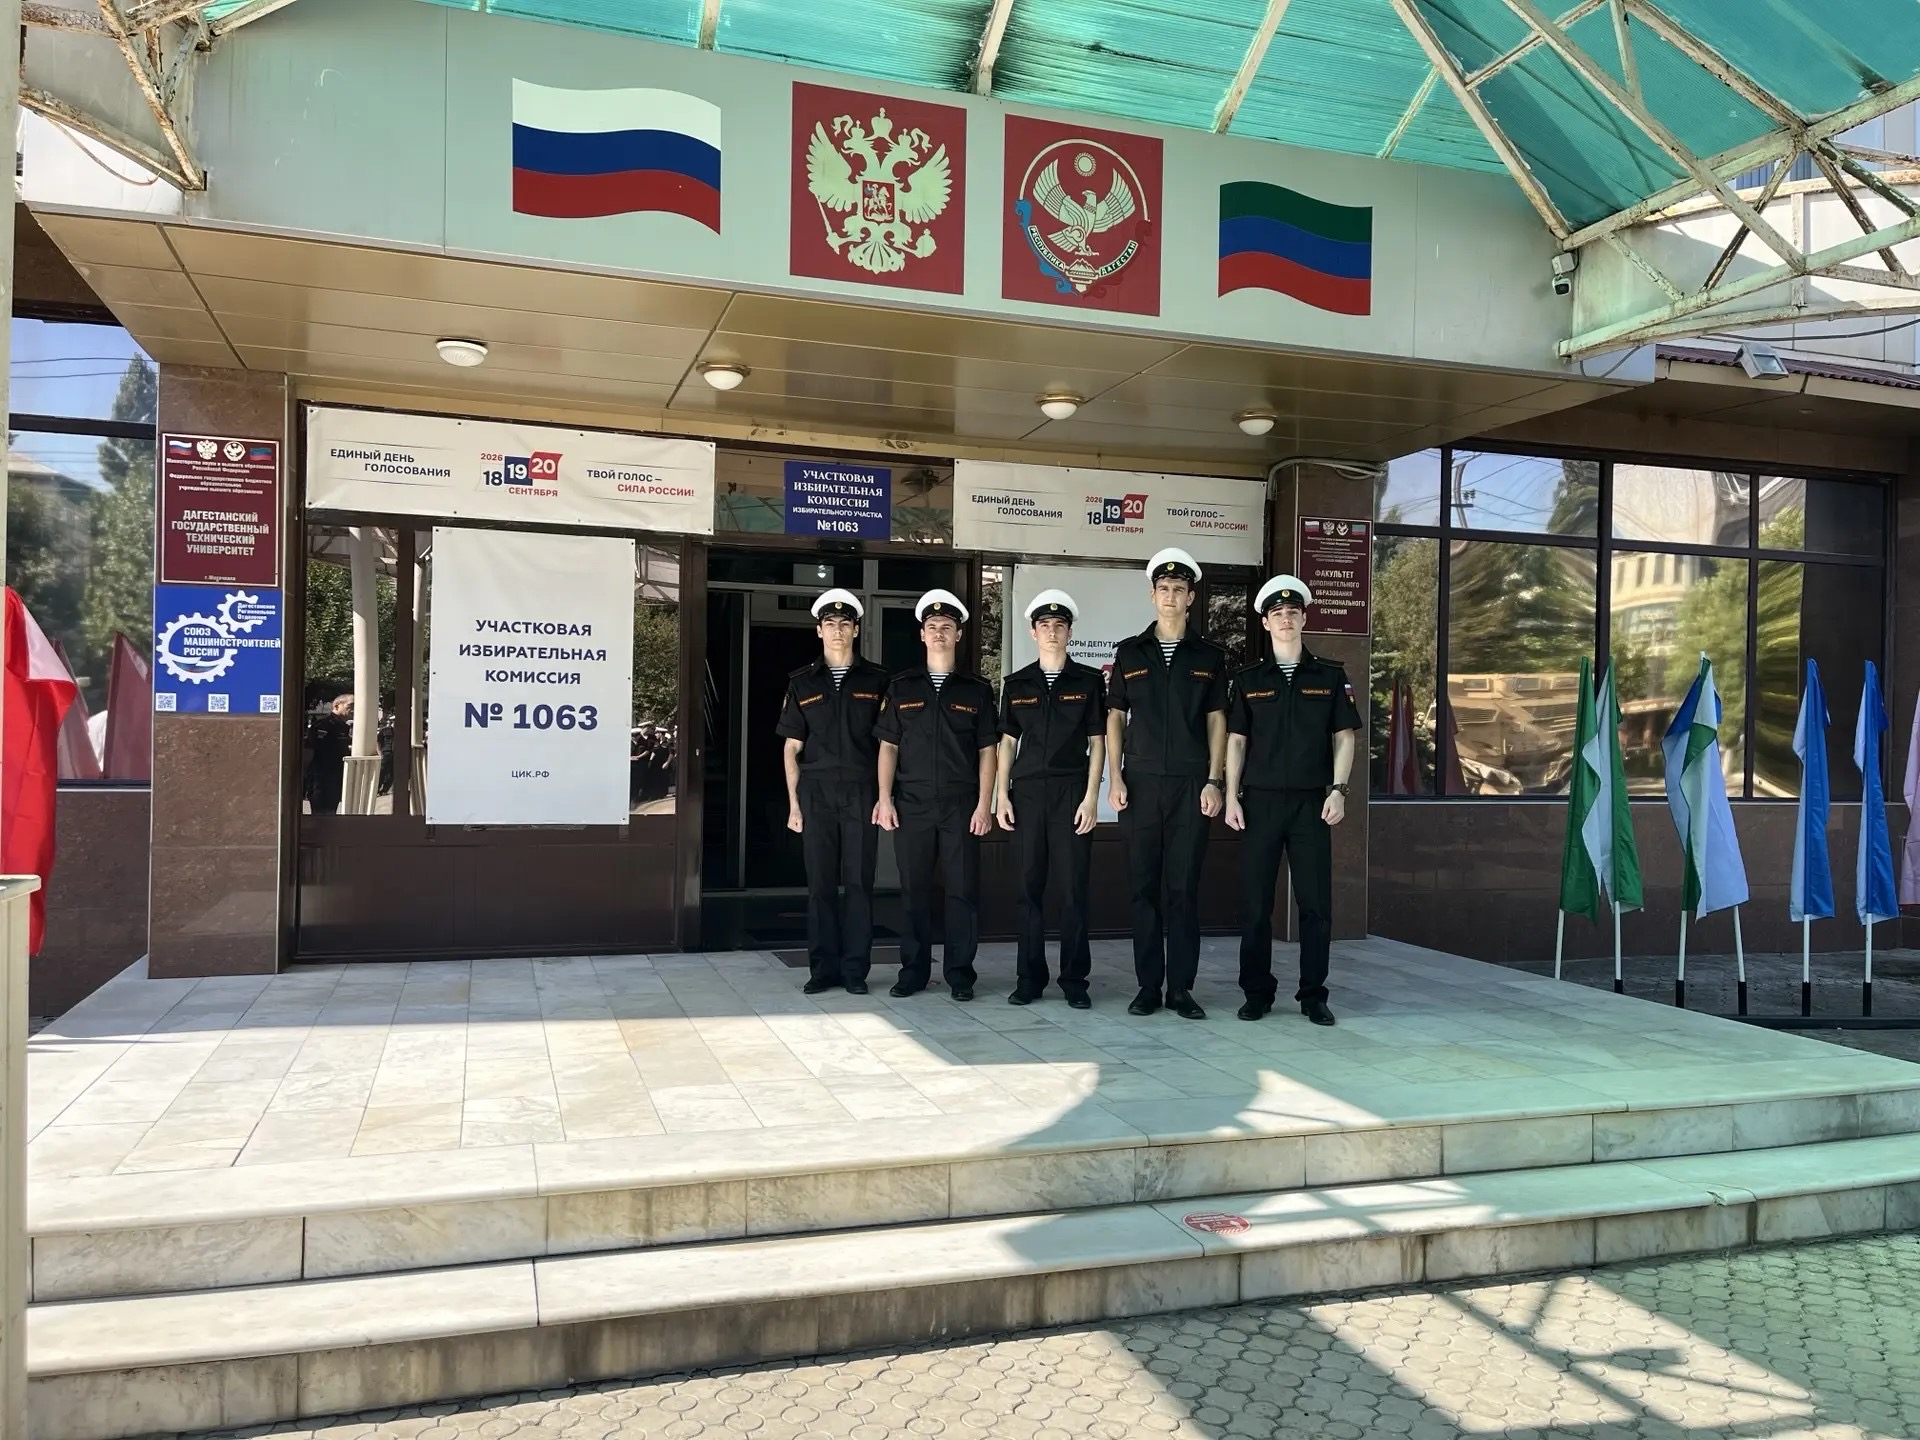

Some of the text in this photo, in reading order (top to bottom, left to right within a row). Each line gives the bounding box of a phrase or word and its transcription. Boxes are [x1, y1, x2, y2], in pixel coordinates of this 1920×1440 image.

[1030, 226, 1137, 276] РЕСПУБЛИКА ДАГЕСТАН
[330, 448, 415, 464] ЕДИНЫЙ ДЕНЬ
[481, 453, 503, 462] 2026
[364, 463, 451, 478] ГОЛОСОВАНИЯ
[483, 457, 556, 486] 18 19 20
[586, 469, 615, 480] ТВОЙ
[617, 471, 653, 483] ГОЛОС
[803, 469, 874, 484] УЧАСТКОВАЯ
[508, 487, 558, 497] СЕНТЯБРЯ
[617, 484, 694, 497] СИЛА РОССИИ!
[793, 481, 883, 497] ИЗБИРАТЕЛЬНАЯ
[807, 495, 869, 508] КОМИССИЯ
[971, 494, 1035, 507] ЕДИНЫЙ ДЕНЬ
[183, 510, 259, 523] ДАГЕСТАНСКИЙ
[792, 507, 883, 519] ИЗБИРАТЕЛЬНОГО УЧАСТКА
[997, 506, 1063, 519] ГОЛОСОВАНИЯ
[1087, 499, 1143, 525] 18 19 20
[1166, 507, 1189, 517] ТВОЙ
[1190, 509, 1218, 519] ГОЛОС
[171, 521, 270, 535] ГОСУДАРСТВЕННЫЙ
[817, 520, 859, 533] №1063
[1106, 525, 1144, 534] СЕНТЯБРЯ
[1190, 520, 1248, 531] СИЛА РОССИИ!
[186, 533, 255, 545] ТЕХНИЧЕСКИЙ
[187, 544, 255, 556] УНИВЕРСИТЕТ
[1315, 570, 1354, 579] ФАКУЛЬТЕТ
[1309, 579, 1360, 588] ДОПОЛНИТЕЛЬНОГО
[1315, 589, 1353, 597] ОБРАЗОВАНИЯ
[1310, 598, 1366, 607] РОФЕССИОНАЛЬНОГО
[184, 627, 211, 636] СОЮЗ
[475, 619, 592, 636] УЧАСТКОВАЯ
[183, 637, 281, 648] МАШИНОСТРОИТЕЛЕЙ
[184, 647, 220, 656] РОССИИ
[459, 644, 607, 661] ИЗБИРАТЕЛЬНАЯ
[485, 669, 581, 685] КОМИССИЯ
[464, 702, 598, 730] № 1063
[511, 769, 550, 779] ЦИК.РФ
